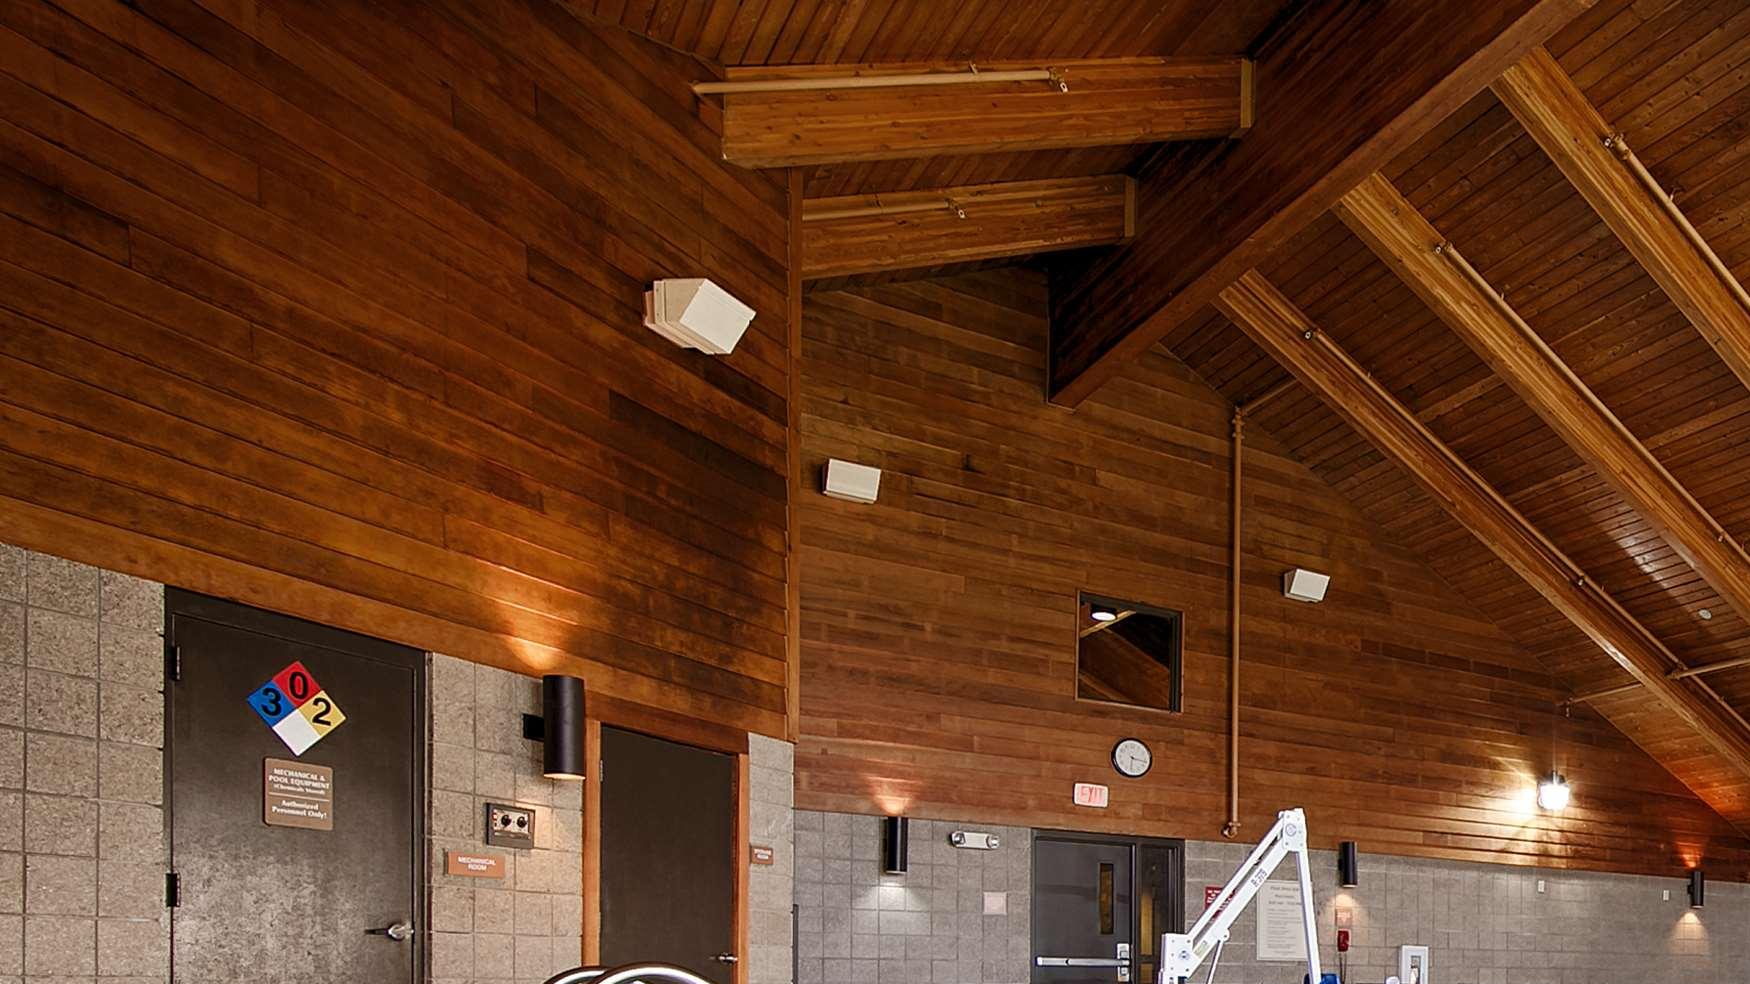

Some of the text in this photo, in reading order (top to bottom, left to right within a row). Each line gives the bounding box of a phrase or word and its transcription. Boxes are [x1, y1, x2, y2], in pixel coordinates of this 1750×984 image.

[289, 671, 309, 700] 0
[260, 688, 282, 717] 3
[311, 697, 332, 727] 2
[268, 775, 330, 789] POOL EQUIPMENT
[273, 768, 319, 780] MECHANICAL
[1080, 785, 1106, 805] EXIT
[467, 863, 488, 871] ROOM
